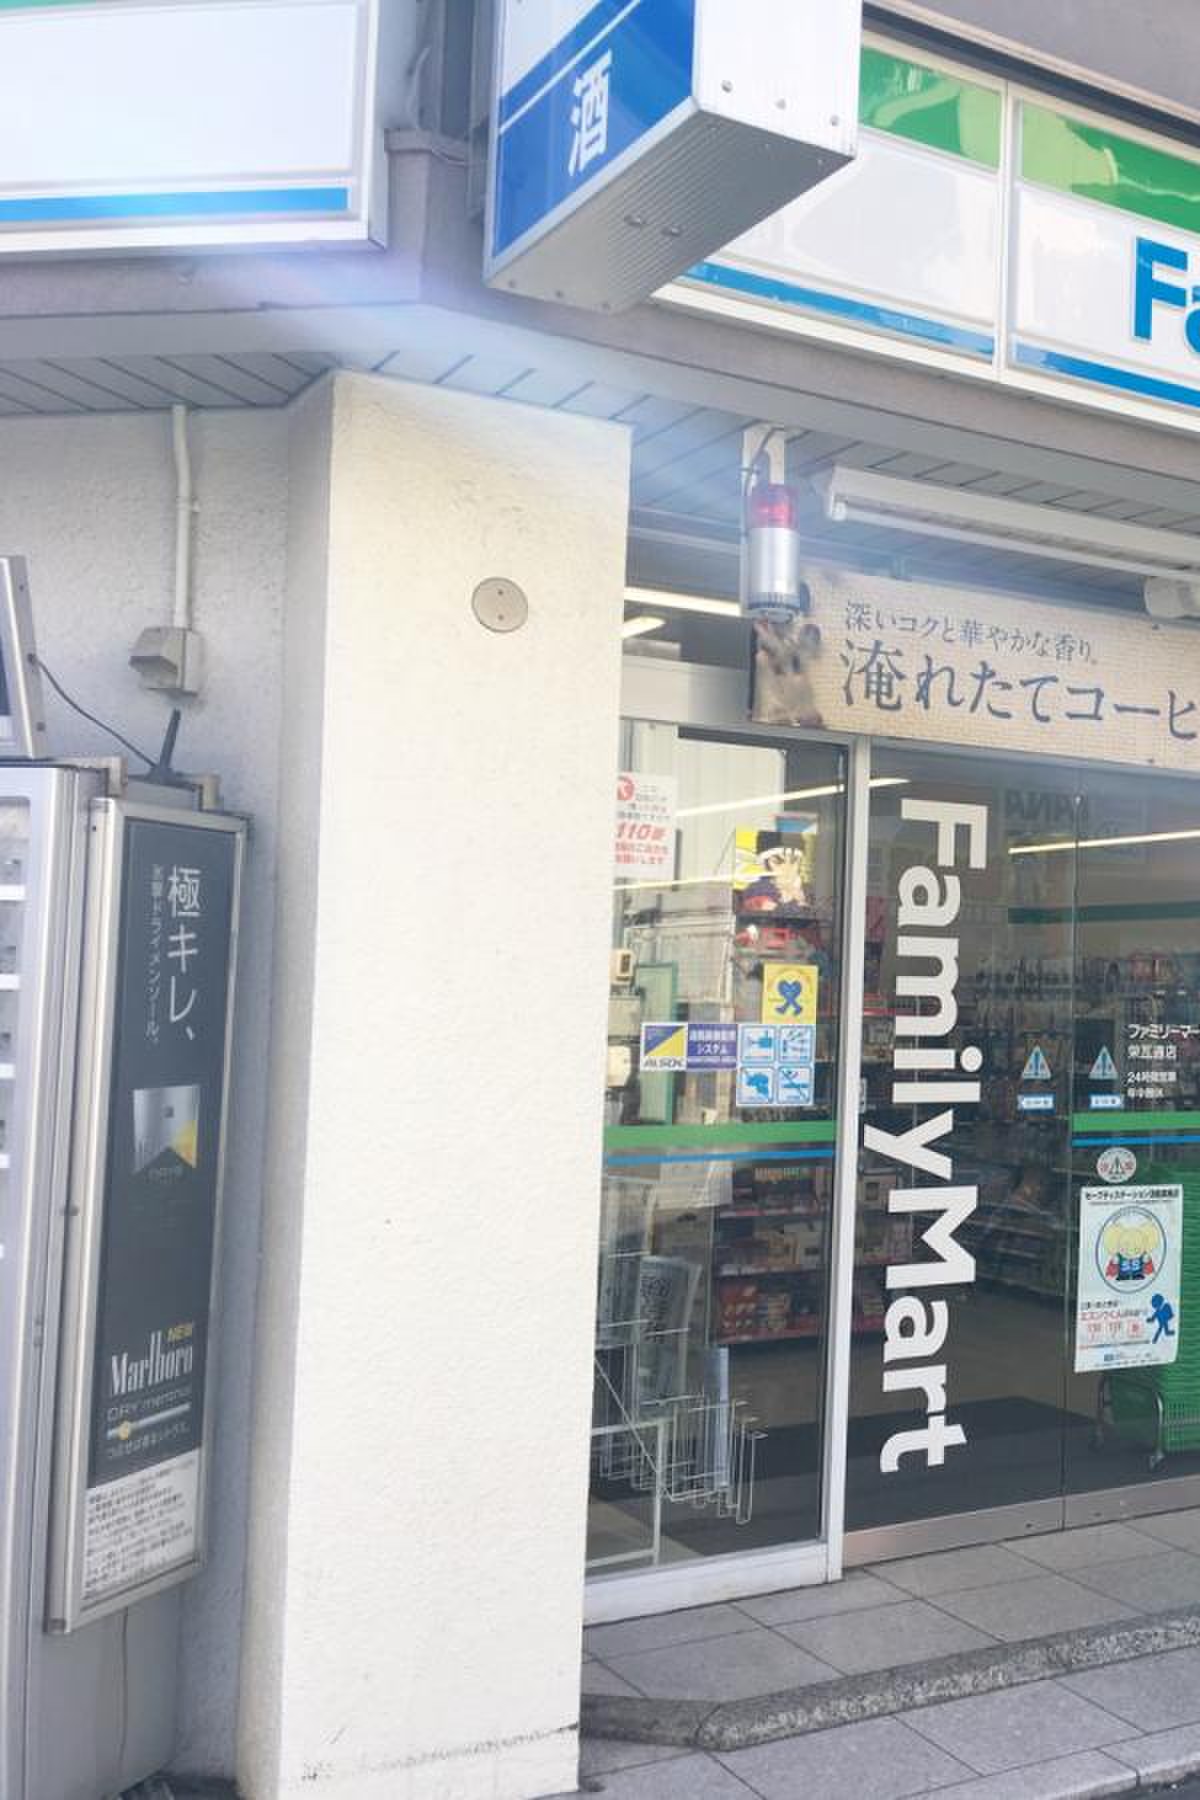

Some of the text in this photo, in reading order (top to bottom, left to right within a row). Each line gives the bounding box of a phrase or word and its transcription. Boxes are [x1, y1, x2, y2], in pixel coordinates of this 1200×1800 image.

[568, 48, 613, 177] 酒
[864, 797, 990, 1473] FamilyMart
[110, 1328, 194, 1396] Marlboro
